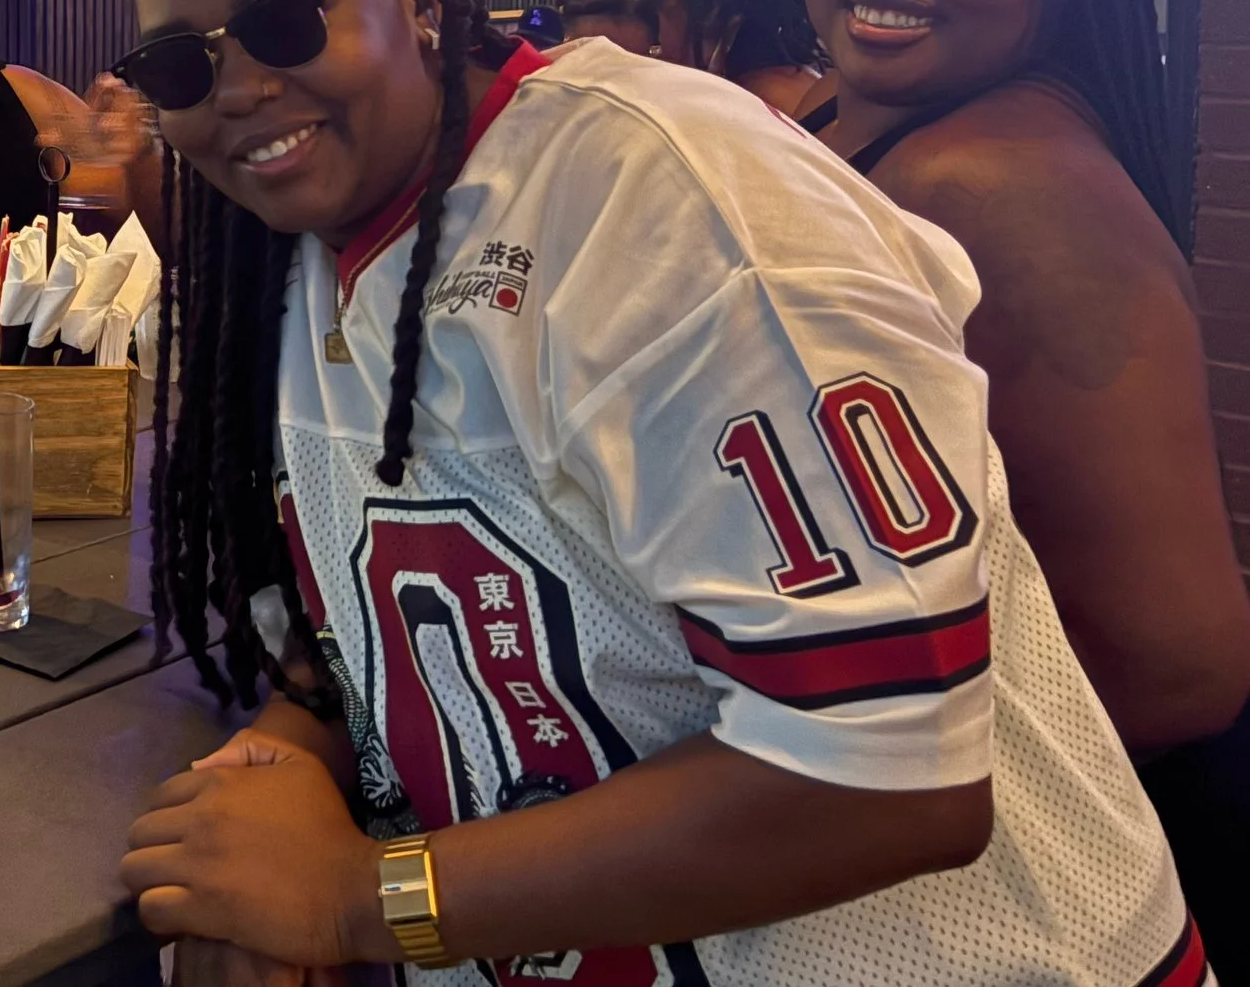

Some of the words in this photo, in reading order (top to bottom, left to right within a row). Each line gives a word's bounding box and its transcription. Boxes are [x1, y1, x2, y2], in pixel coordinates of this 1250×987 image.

[479, 241, 534, 276] 渋谷
[713, 371, 979, 599] 10
[473, 572, 524, 660] 東京
[504, 681, 569, 748] 日本
